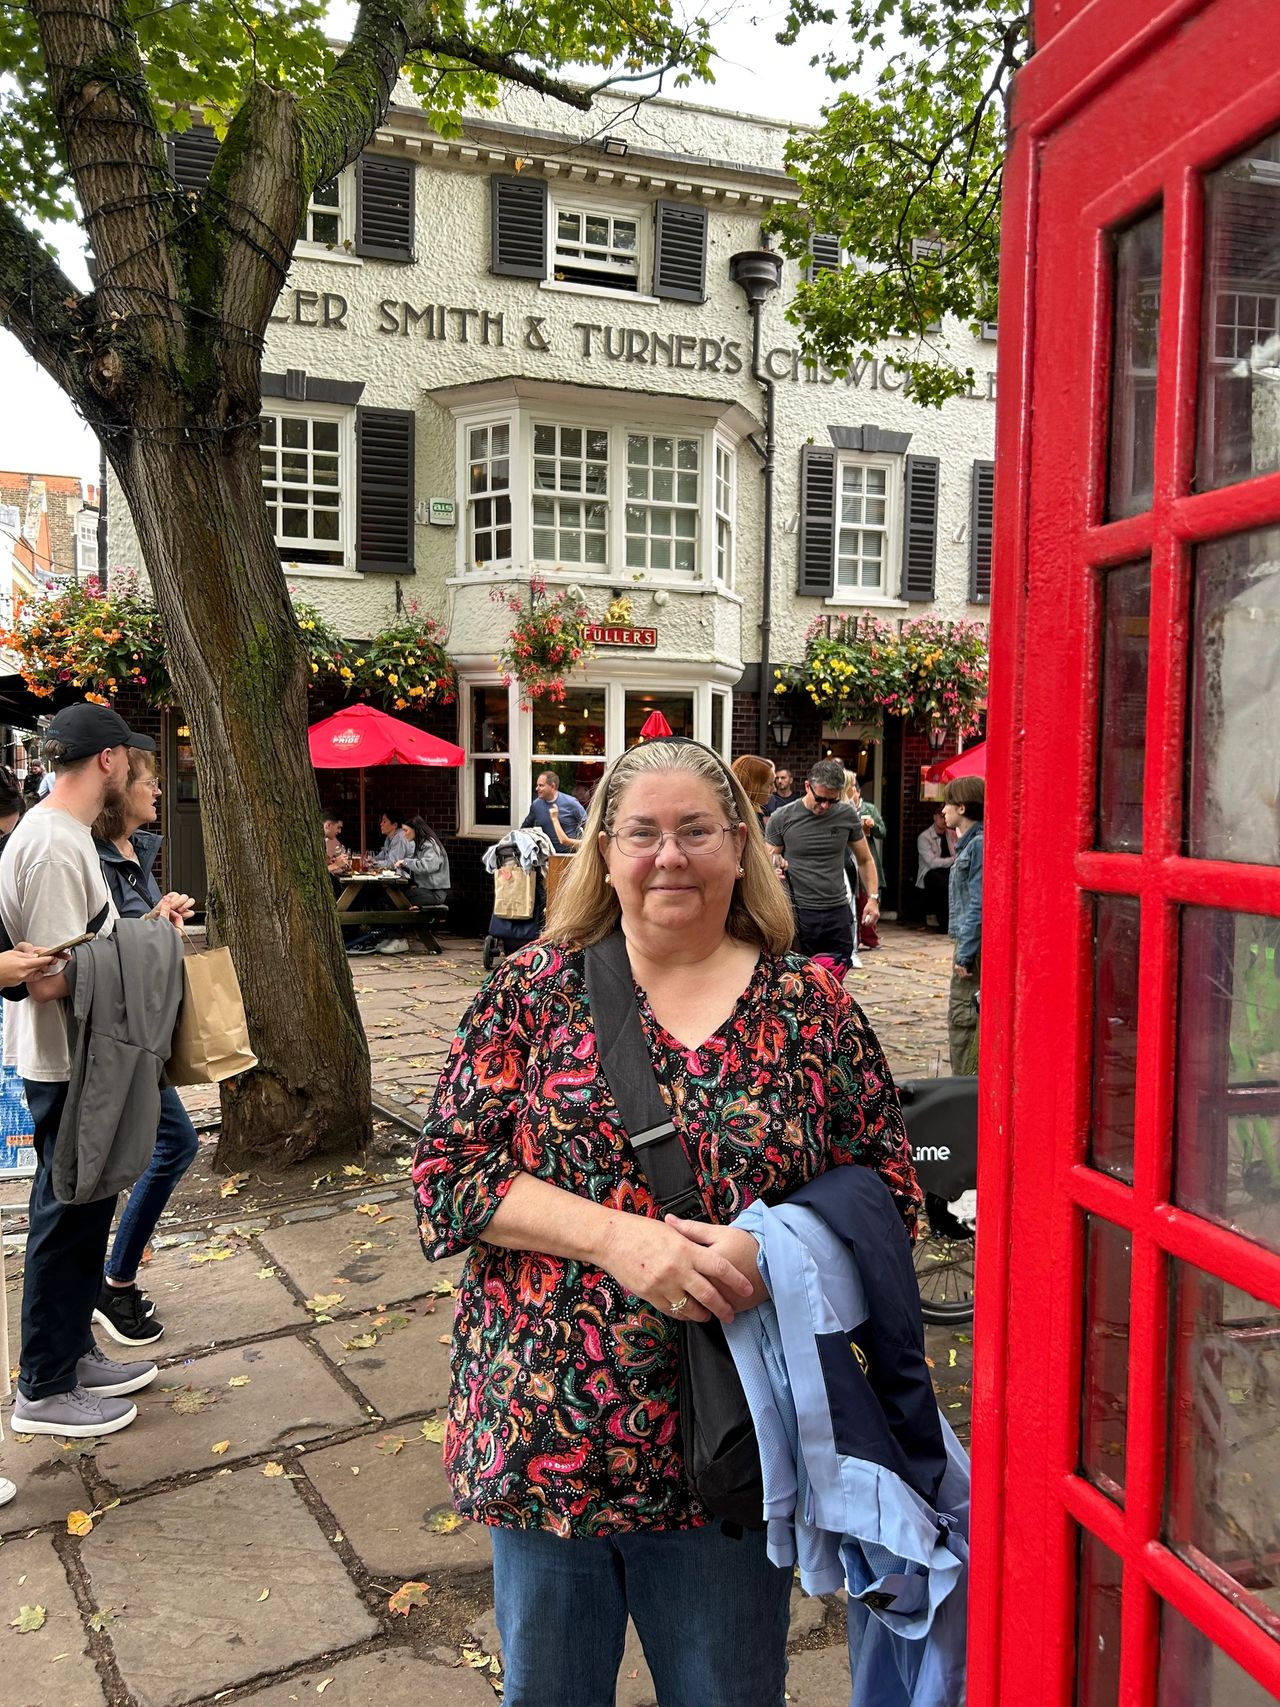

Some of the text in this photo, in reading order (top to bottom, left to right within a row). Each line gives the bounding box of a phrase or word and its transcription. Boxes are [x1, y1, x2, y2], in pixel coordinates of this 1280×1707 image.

[379, 299, 504, 347] SMITH
[524, 315, 551, 353] &
[573, 321, 743, 375] TURNER'S
[583, 627, 653, 645] FULLER'S
[911, 1145, 951, 1161] ime
